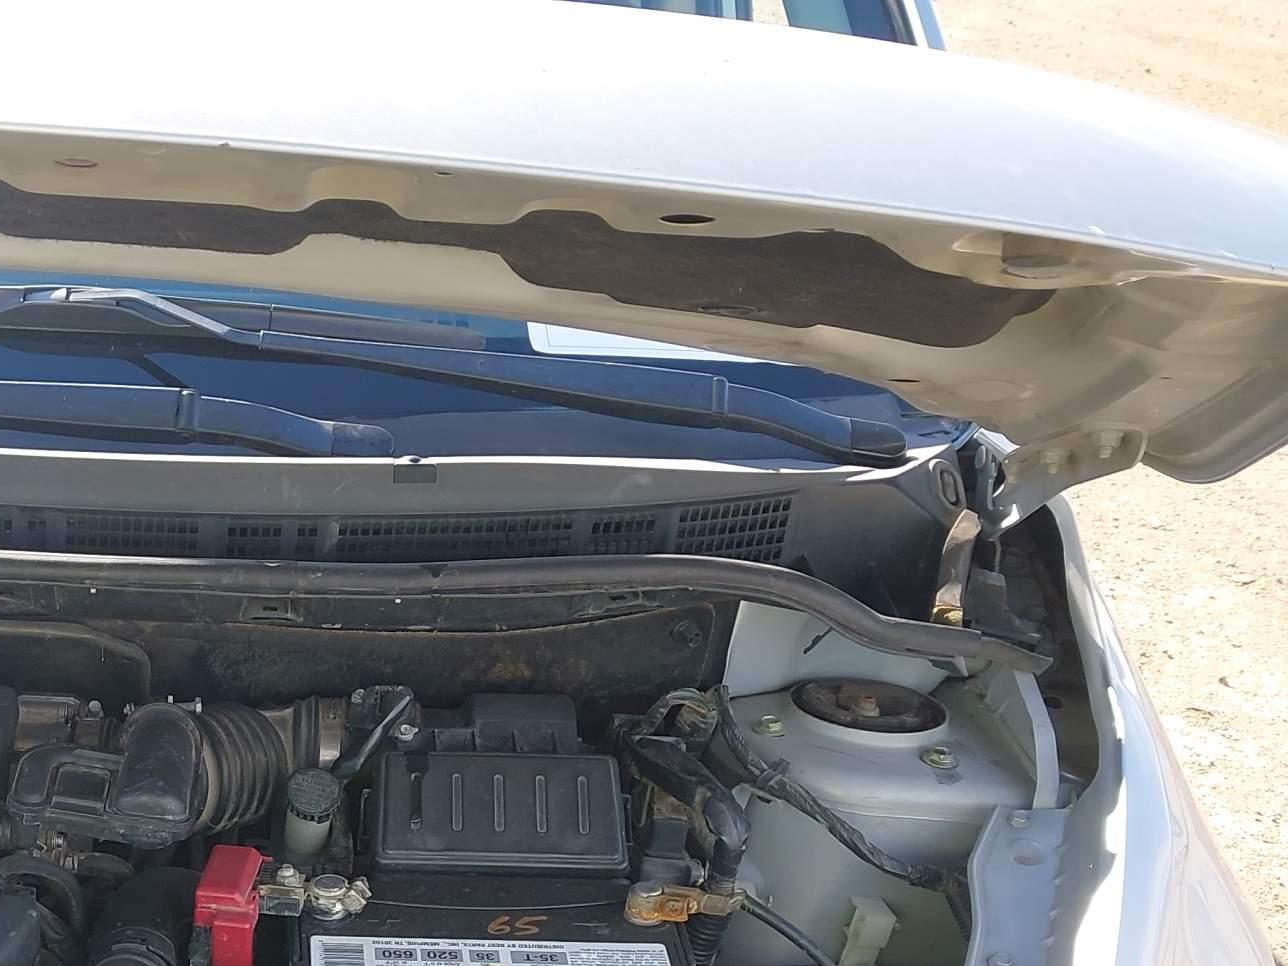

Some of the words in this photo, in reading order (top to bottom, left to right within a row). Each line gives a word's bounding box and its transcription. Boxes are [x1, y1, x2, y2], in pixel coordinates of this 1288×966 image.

[382, 950, 413, 958] 650
[427, 950, 458, 959] 520
[476, 953, 494, 961] 35
[523, 954, 558, 962] 35-T
